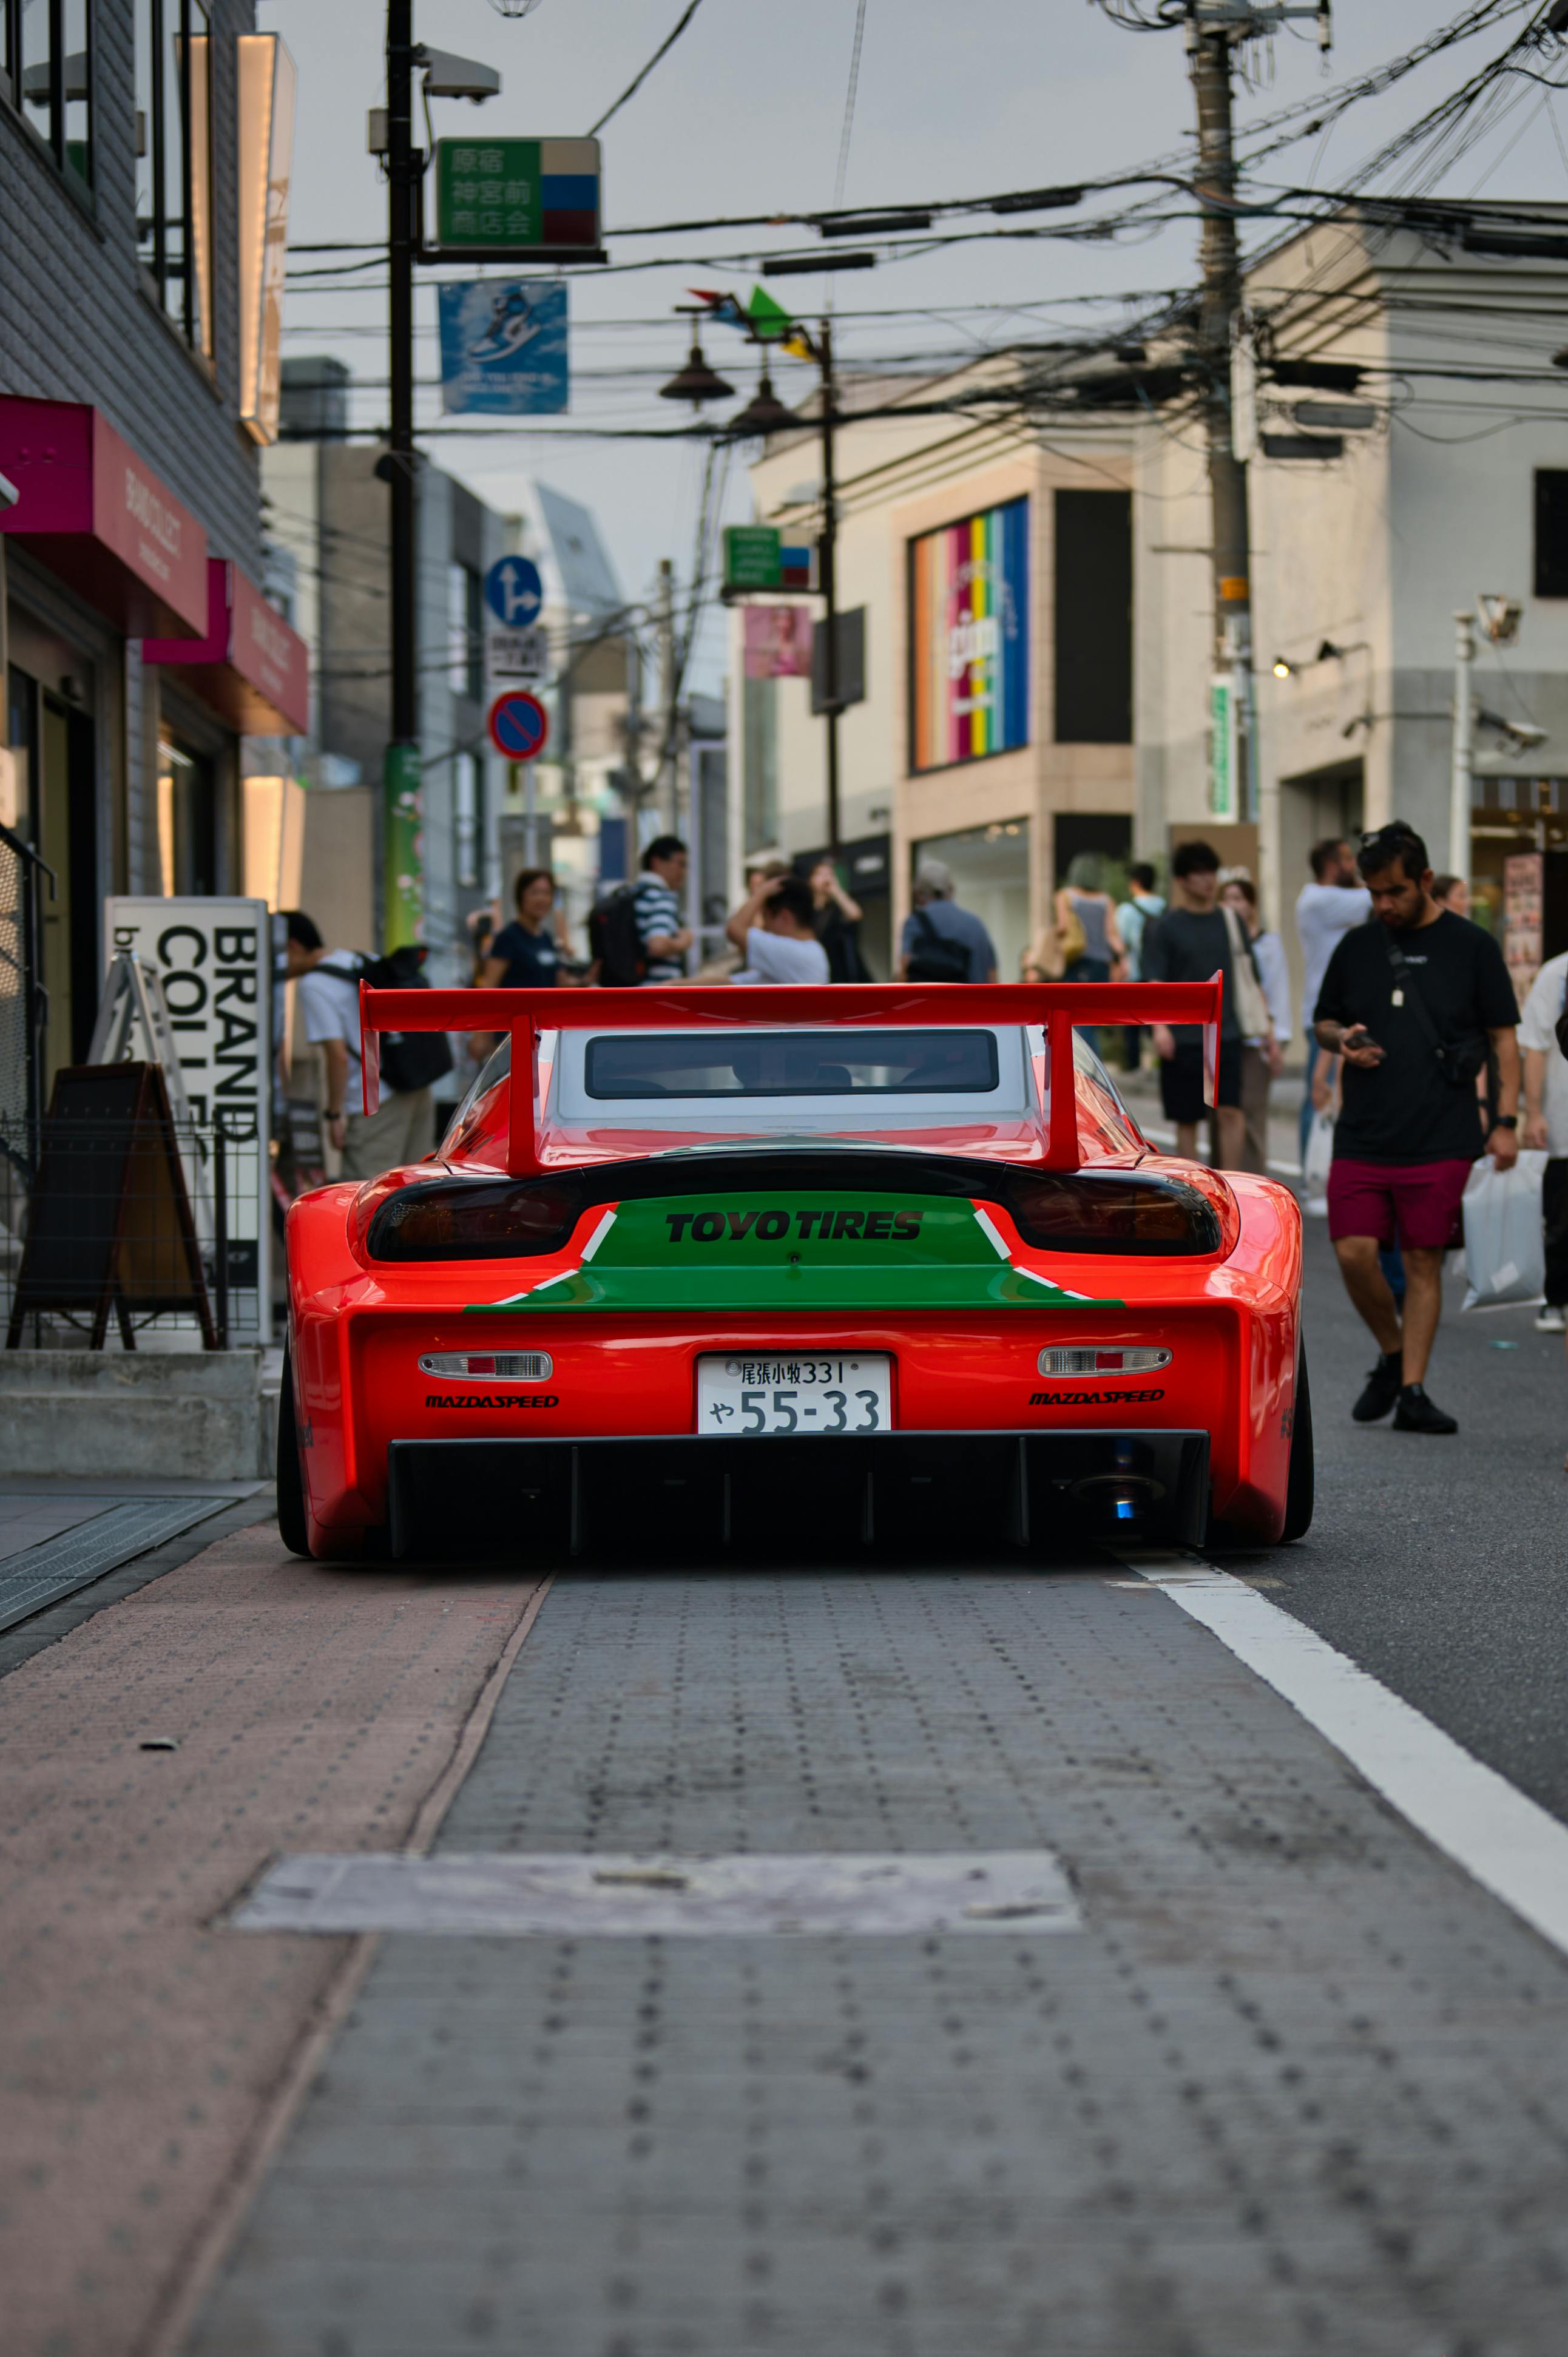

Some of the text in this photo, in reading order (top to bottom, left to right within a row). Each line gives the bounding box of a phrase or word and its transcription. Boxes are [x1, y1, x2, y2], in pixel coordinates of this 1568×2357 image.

[451, 149, 504, 173] 原宿
[451, 179, 532, 205] 神宮前
[451, 210, 532, 235] 商店会
[214, 927, 258, 1142] BRAND
[666, 1210, 924, 1242] TOYO TIRES
[425, 1395, 559, 1408] MAZDASPEED
[1029, 1389, 1165, 1405] MAZDASPEED
[709, 1390, 879, 1433] や 55-33
